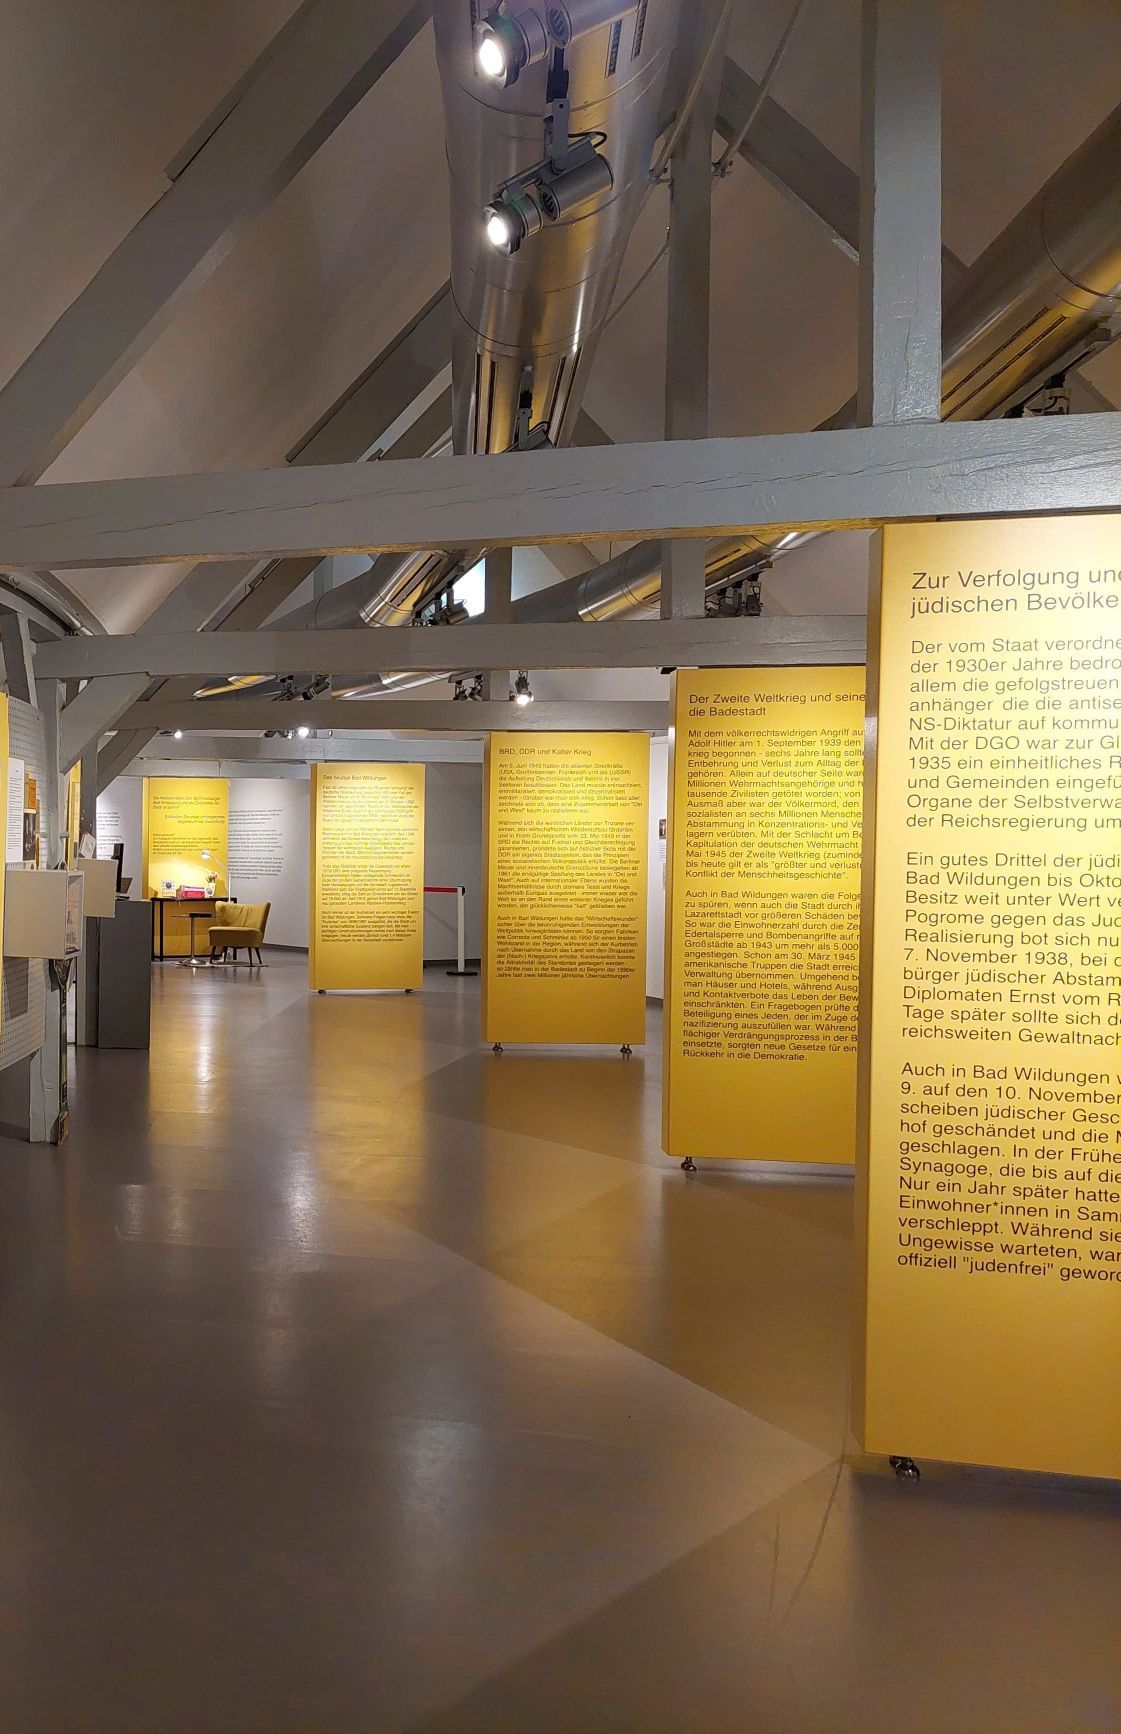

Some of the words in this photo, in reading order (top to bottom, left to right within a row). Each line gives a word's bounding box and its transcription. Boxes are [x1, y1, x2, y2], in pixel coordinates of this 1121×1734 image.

[912, 573, 950, 590] Zur
[957, 569, 1079, 590] Verfolgung
[910, 595, 1017, 619] jüdischen
[911, 641, 943, 654] Der
[948, 642, 985, 653] vom
[992, 639, 1039, 652] Staat
[910, 660, 939, 673] der
[945, 659, 1007, 672] 1930er
[1012, 658, 1063, 671] Jahre
[689, 694, 710, 704] Der
[712, 694, 750, 703] Zweite
[753, 693, 807, 705] Weltkrieg
[810, 692, 832, 702] und
[835, 692, 866, 702] seine
[688, 707, 706, 717] die
[709, 706, 766, 716] Badestadt
[909, 718, 1012, 731] NS-Diktatur
[1018, 717, 1046, 730] auf
[909, 737, 934, 750] Mit
[940, 737, 969, 750] der
[975, 737, 1020, 750] DGO
[1026, 740, 1059, 750] war
[1065, 740, 1094, 749] zur
[906, 814, 935, 827] der
[941, 814, 1087, 831] Reichsregierung
[906, 871, 940, 885] Bad
[946, 871, 1040, 889] Wildungen
[1047, 873, 1073, 887] bis
[904, 947, 918, 961] 7.
[926, 948, 1018, 964] November
[1025, 951, 1073, 968] 1938,
[1080, 952, 1107, 967] bei
[901, 1061, 945, 1077] Auch
[952, 1064, 966, 1078] in
[973, 1065, 1007, 1080] Bad
[1014, 1067, 1110, 1087] Wildungen
[901, 1080, 916, 1095] 9.
[923, 1082, 950, 1096] auf
[955, 1083, 988, 1098] den
[995, 1085, 1021, 1100] 10.
[1029, 1086, 1121, 1105] November
[899, 1140, 1005, 1159] geschlagen.
[1013, 1144, 1028, 1158] In
[1034, 1145, 1064, 1160] der
[899, 1232, 994, 1253] Ungewisse
[1000, 1242, 1082, 1262] warteten,
[898, 1251, 956, 1269] offiziell
[963, 1256, 1054, 1276] "judenfrei"
